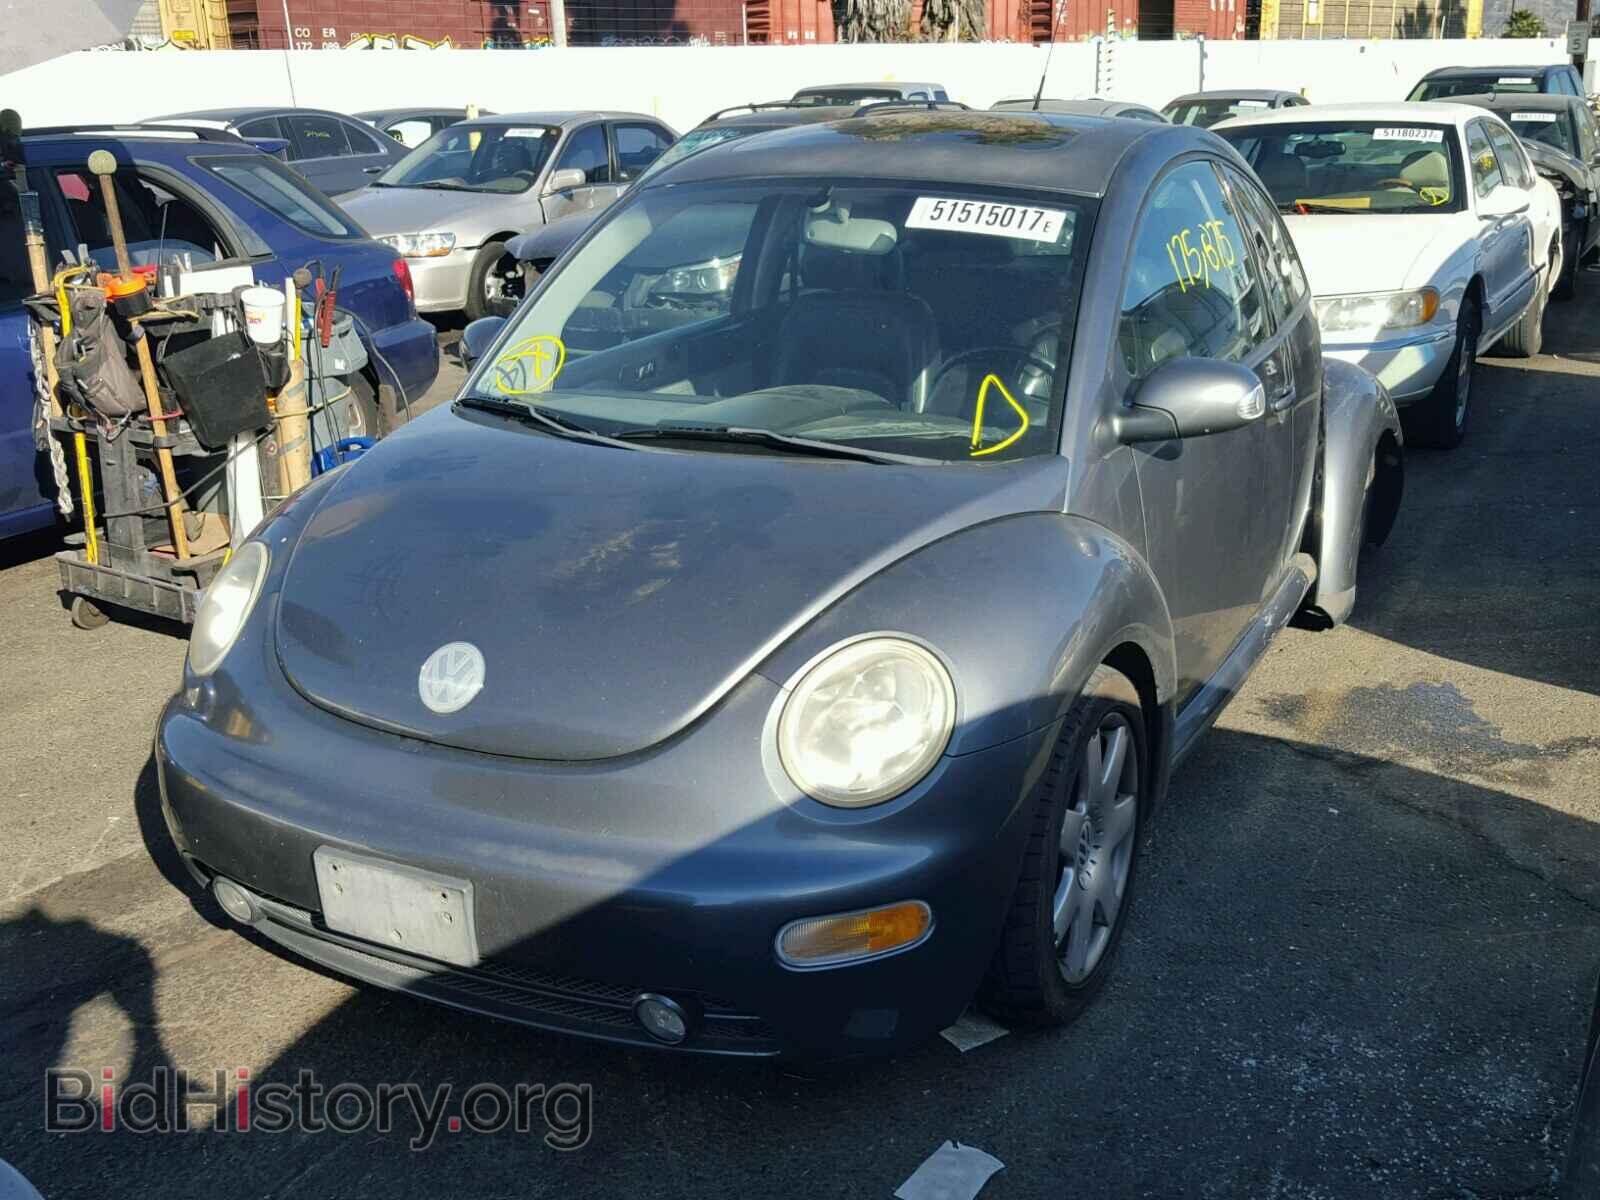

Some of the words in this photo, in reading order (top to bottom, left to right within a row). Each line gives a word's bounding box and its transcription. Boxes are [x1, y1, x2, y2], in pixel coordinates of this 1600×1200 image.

[294, 27, 311, 38] CO
[322, 27, 337, 38] ER
[1573, 38, 1582, 50] 5
[929, 199, 1044, 231] 51515017
